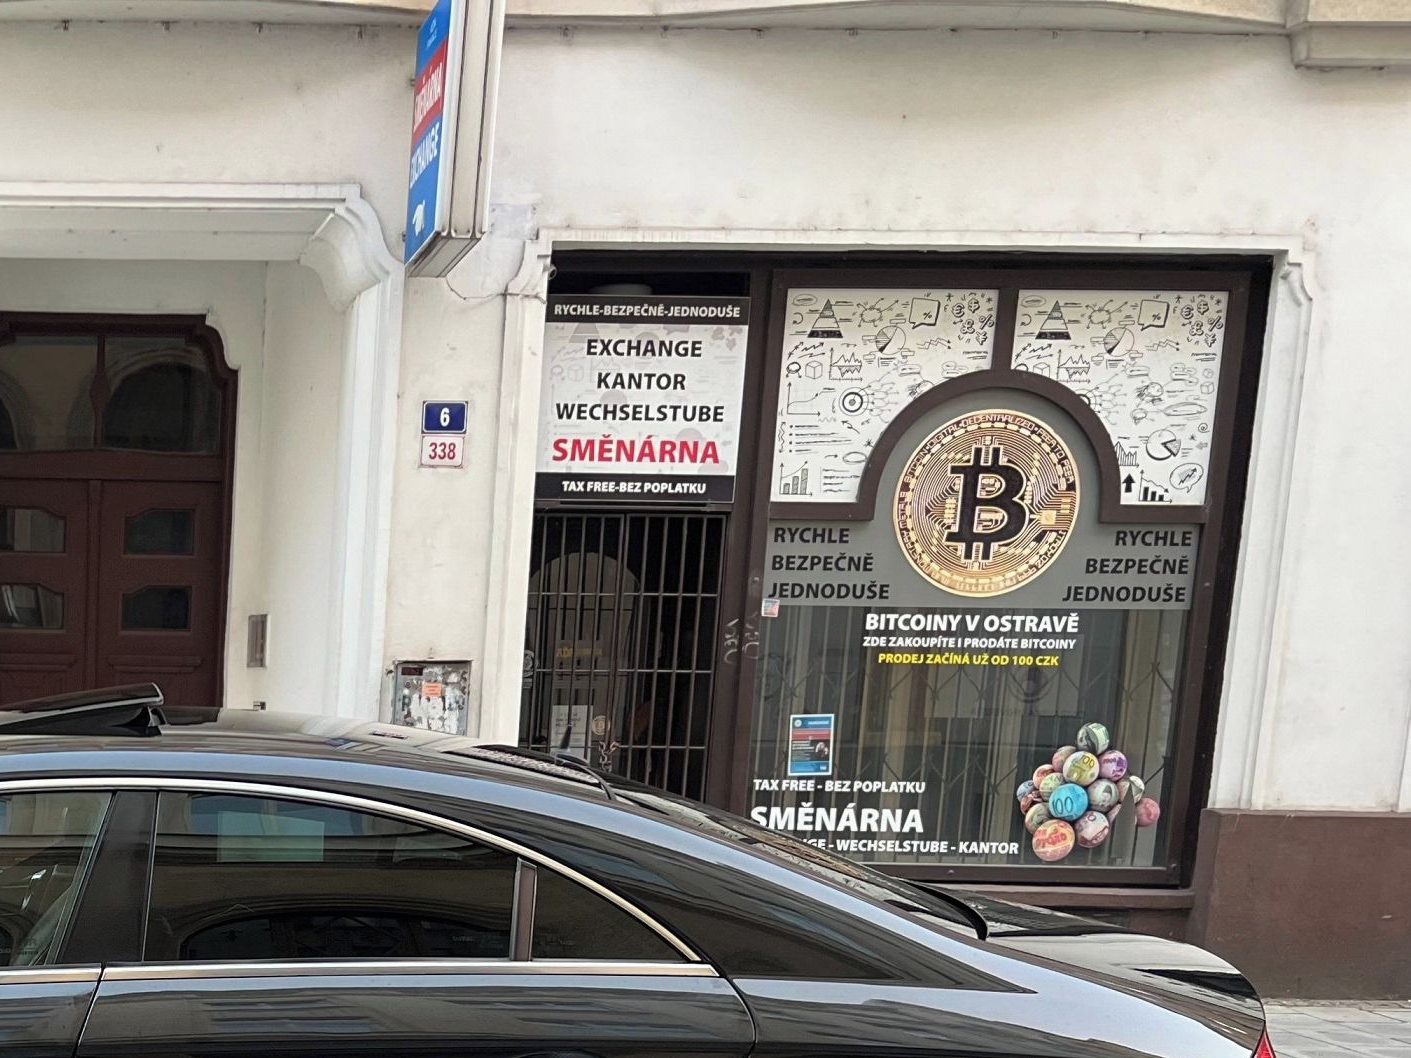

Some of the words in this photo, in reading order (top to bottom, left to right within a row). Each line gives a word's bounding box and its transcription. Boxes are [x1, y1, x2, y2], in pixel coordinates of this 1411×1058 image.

[587, 339, 702, 357] EXCHANGE
[597, 372, 686, 390] KANTOR
[440, 407, 450, 427] 6
[556, 403, 724, 422] WECHSELSTUBE
[429, 442, 456, 461] 338
[552, 434, 720, 464] SMĚNÁRNA
[562, 481, 584, 492] TAX
[644, 482, 706, 494] POPLATKU
[774, 527, 850, 544] RYCHLE
[1115, 530, 1193, 547] RYCHLE
[771, 552, 874, 572] BEZPEČNĚ
[1085, 555, 1190, 574] BEZPEČNĚ
[768, 580, 890, 599] JEDNODUŠE
[1062, 583, 1186, 602] JEDNODUŠE
[865, 613, 964, 631] BITCOINY
[965, 615, 980, 631] V
[983, 612, 1079, 633] OSTRAVĚ
[862, 637, 887, 647] ZDE
[888, 635, 956, 648] ZAKOUPÍTE
[964, 636, 1019, 649] PRODÁTE
[1020, 639, 1076, 650] BITCOINY
[878, 653, 924, 664] PRODEJ
[925, 652, 971, 665] ZAČÍNÁ
[972, 653, 989, 665] UŽ
[991, 655, 1009, 665] OD
[1012, 656, 1033, 666] 100
[1035, 656, 1059, 666] CZK
[753, 779, 779, 791] TAX
[782, 780, 815, 791] FREE
[824, 780, 851, 792] BEZ
[853, 781, 926, 794] POPLATKU
[750, 802, 924, 833] SMĚNÁRNA
[837, 839, 948, 853] WECHSELSTUBE
[959, 841, 1019, 855] KANTOR
